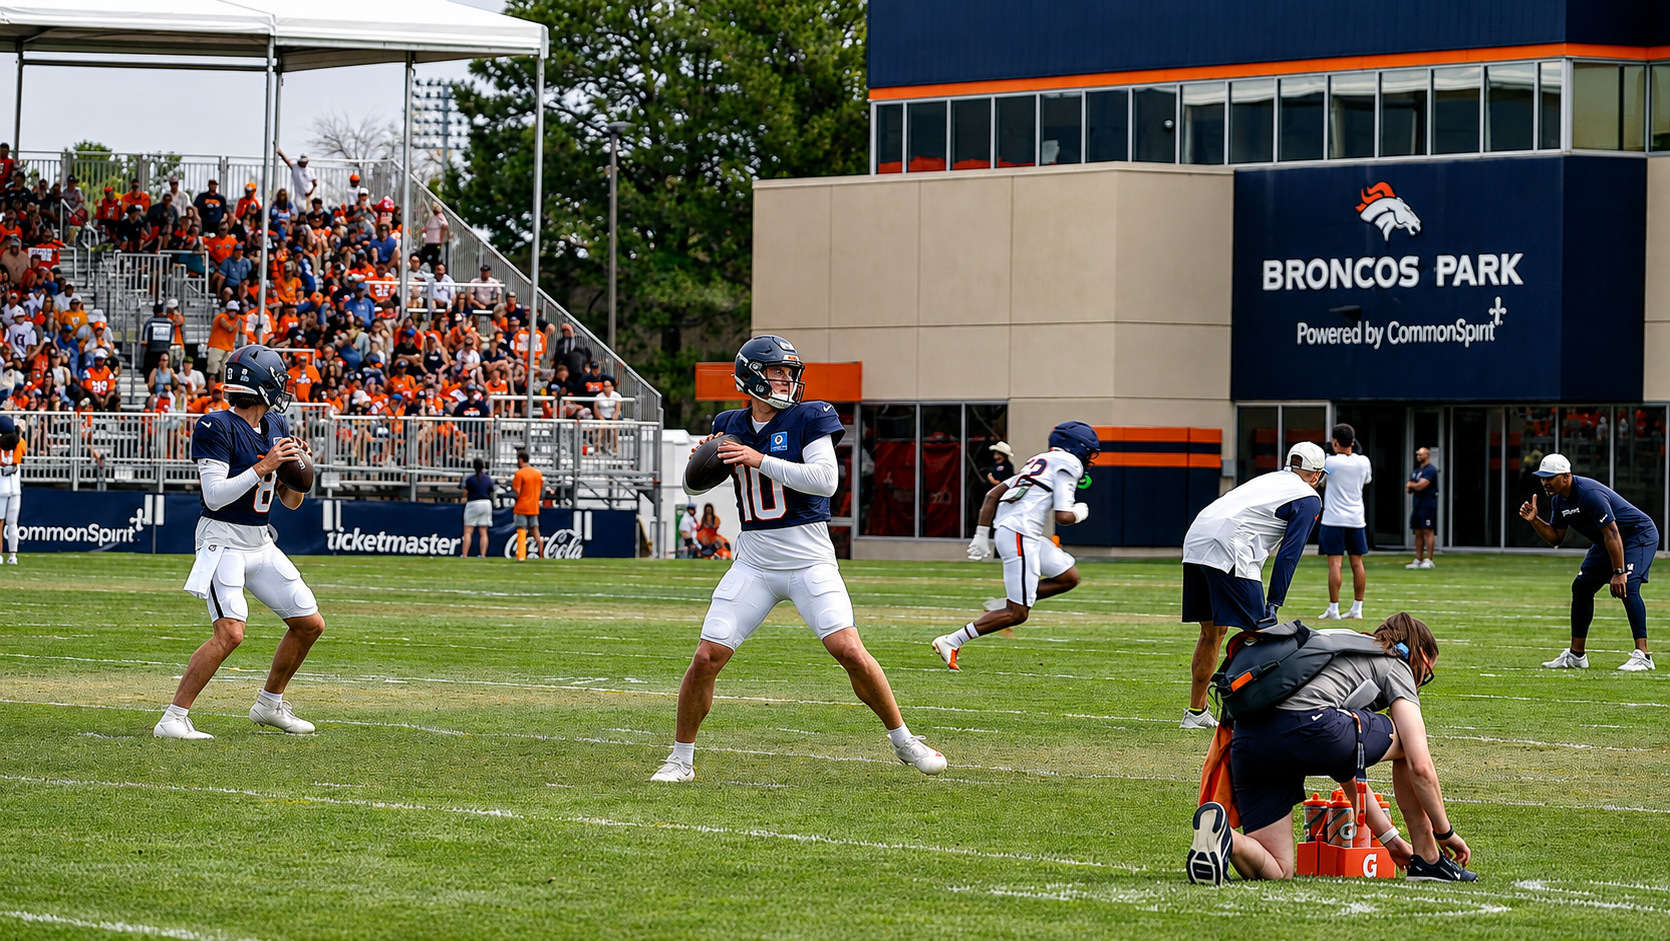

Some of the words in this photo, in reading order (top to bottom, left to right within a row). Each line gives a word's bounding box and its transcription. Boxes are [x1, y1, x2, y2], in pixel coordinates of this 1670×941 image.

[1262, 255, 1420, 291] BRONCOS
[1436, 252, 1524, 287] PARK
[1296, 320, 1362, 346] Powered
[1365, 320, 1384, 350] by
[1387, 317, 1495, 348] CommonSpirit
[252, 469, 278, 514] 8
[734, 463, 787, 522] 10
[326, 527, 461, 556] ticketmaster
[504, 528, 583, 559] C-Cola
[1362, 853, 1378, 878] G
